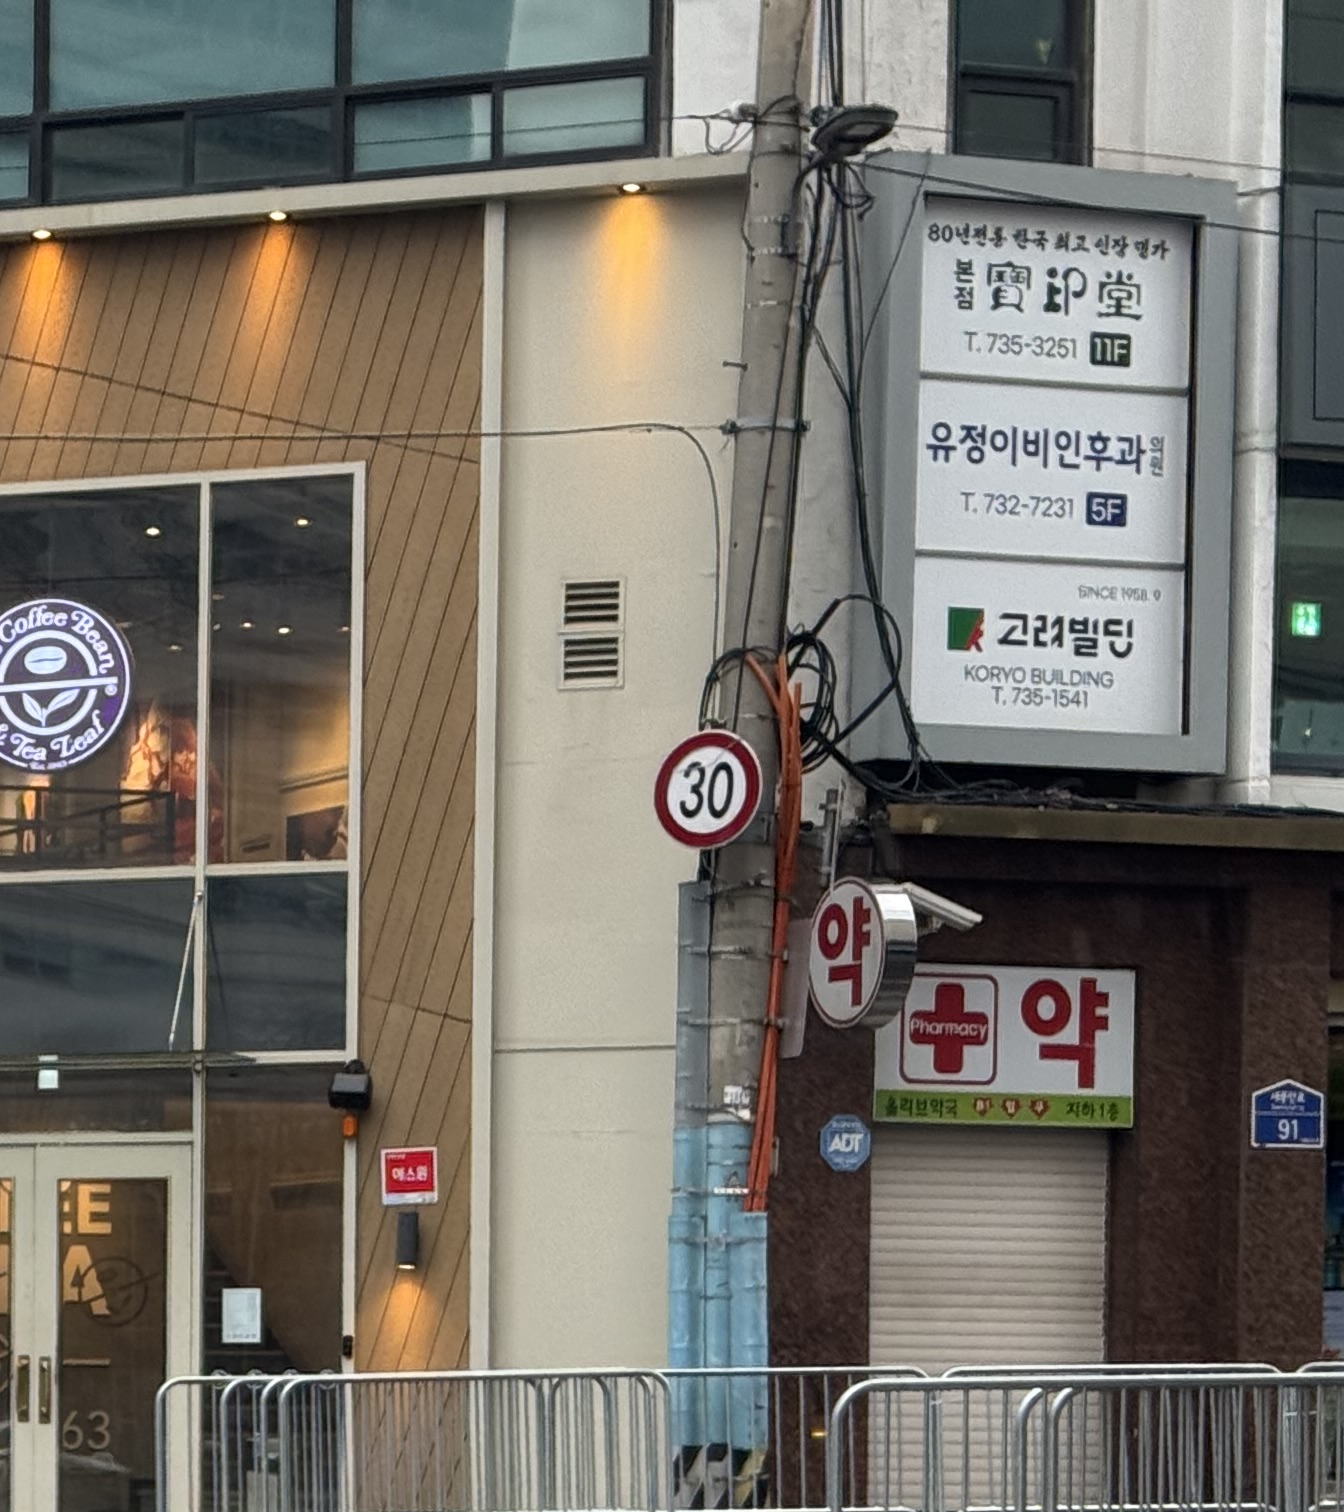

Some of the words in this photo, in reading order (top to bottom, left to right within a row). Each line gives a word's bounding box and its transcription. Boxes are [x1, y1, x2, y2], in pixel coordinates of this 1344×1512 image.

[1013, 228, 1048, 251] 한국
[1054, 232, 1090, 253] 최고
[1134, 238, 1170, 262] 명가
[953, 258, 975, 311] 본점
[925, 421, 1146, 475] 유정이비인후과
[1091, 498, 1123, 523] 5F
[70, 610, 115, 674] Bean
[997, 612, 1134, 659] 고려빌딩
[964, 664, 1026, 685] KORYO
[1030, 668, 1114, 689] BUILDING
[10, 733, 47, 762] Tea
[50, 709, 105, 758] Leaf
[678, 760, 735, 819] 30
[816, 896, 872, 1007] 약
[909, 1017, 989, 1041] Pharmacy
[1019, 976, 1110, 1089] 약
[828, 1132, 864, 1153] ADT
[1278, 1119, 1298, 1140] 91
